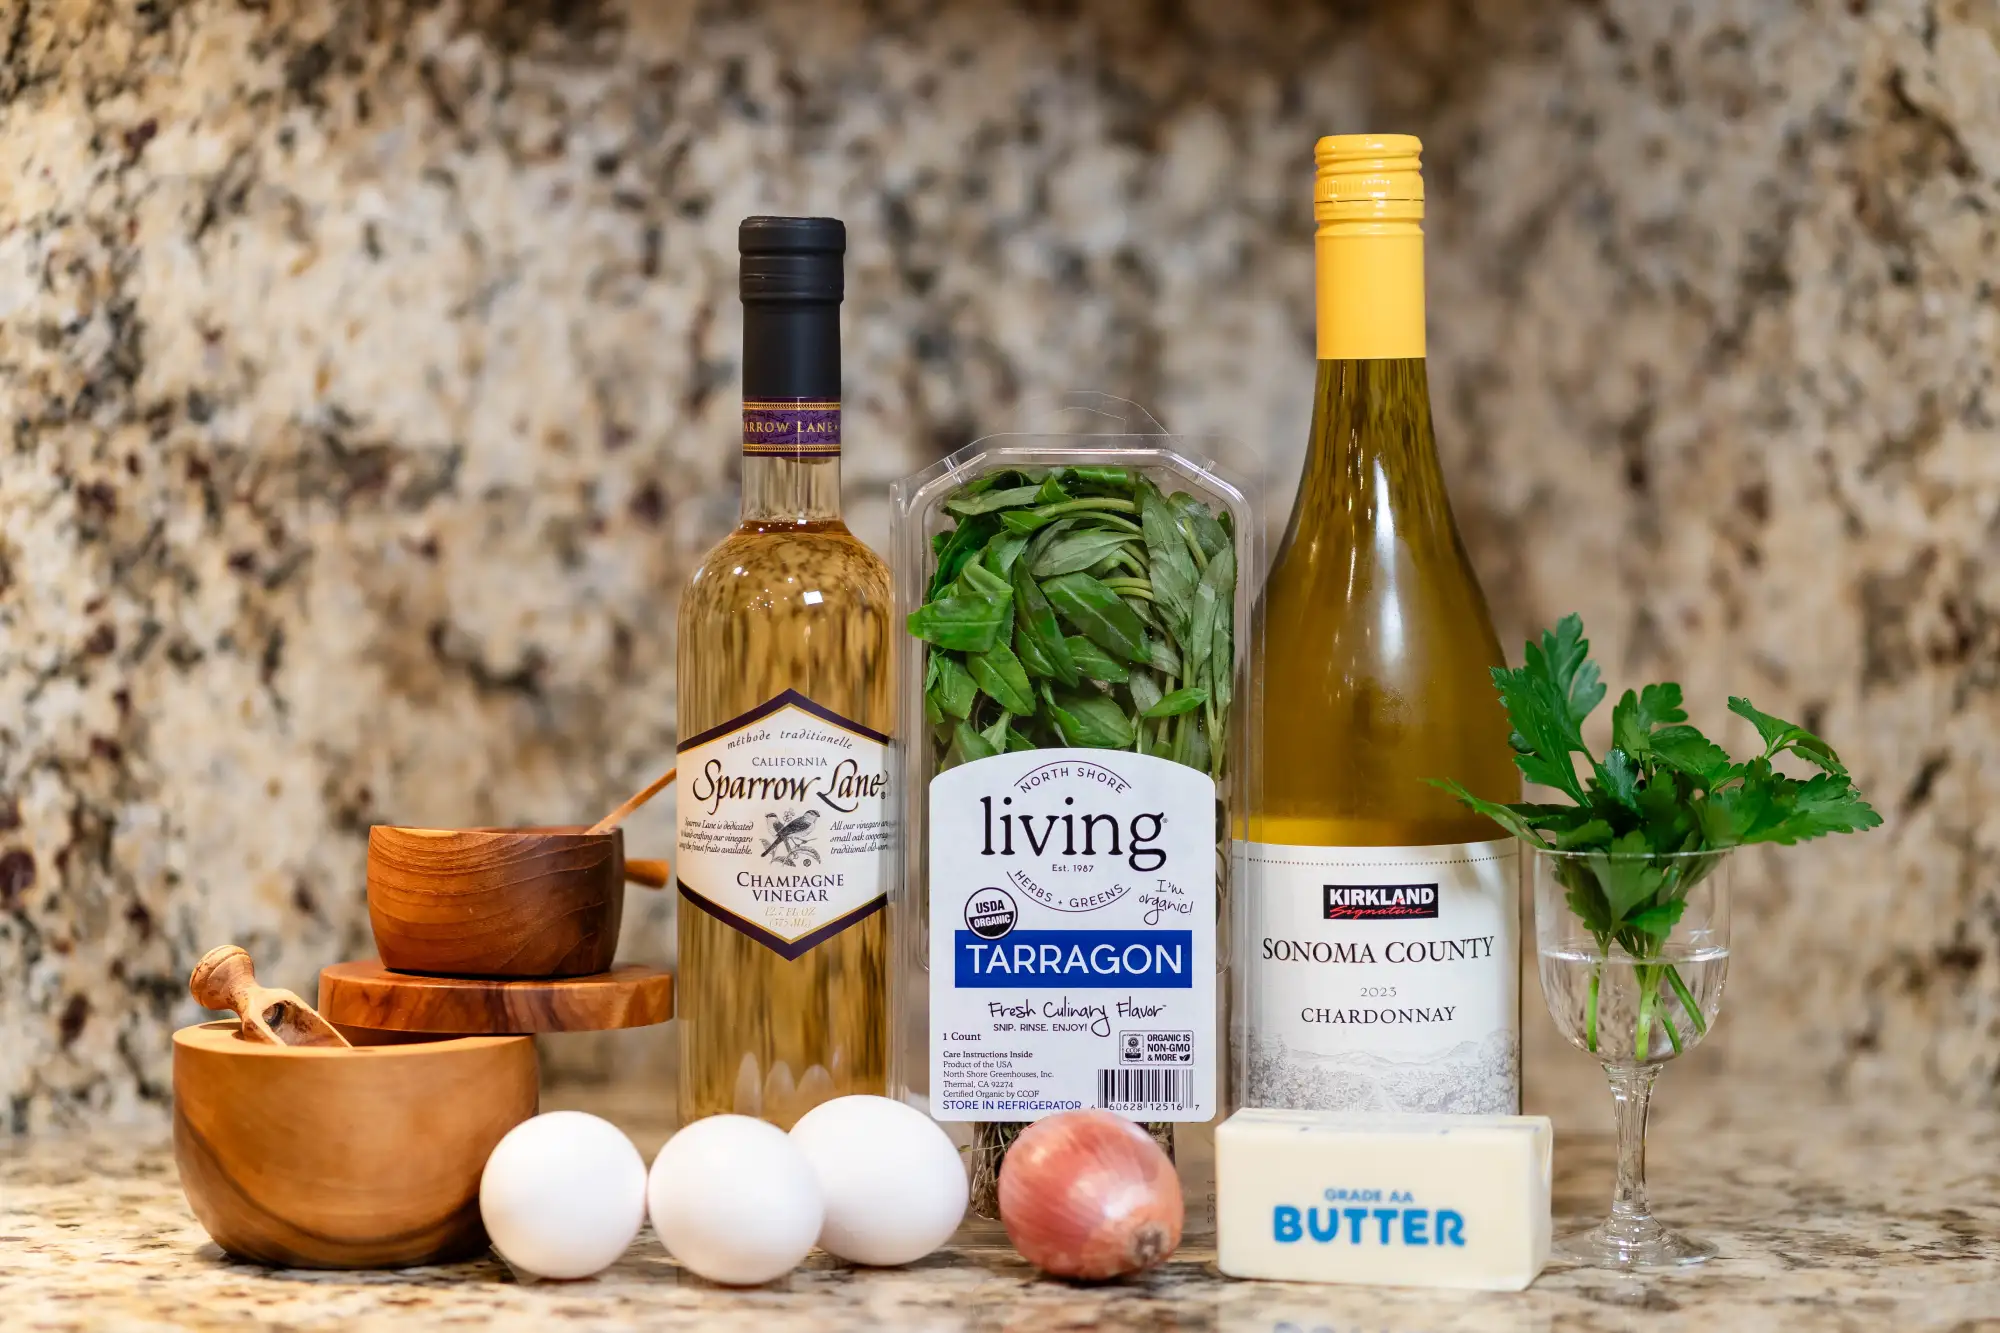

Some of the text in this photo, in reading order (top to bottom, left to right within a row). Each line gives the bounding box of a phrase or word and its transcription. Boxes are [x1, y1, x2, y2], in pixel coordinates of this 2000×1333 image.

[797, 421, 833, 432] LANE
[727, 729, 853, 750] méthode traditionelle
[752, 757, 828, 767] CALIFORNIA
[692, 759, 820, 815] Sparrow
[1020, 767, 1126, 794] NORTH SHORE
[702, 820, 716, 829] Lane
[723, 820, 754, 831] dedicated
[829, 820, 843, 831] All
[725, 833, 753, 843] vinegars
[829, 832, 852, 842] small
[852, 831, 865, 841] oak
[980, 796, 1167, 872] living
[704, 841, 720, 854] fruits
[721, 843, 753, 855] available.
[830, 843, 867, 854] traditional
[1052, 864, 1094, 873] Est. 1987
[736, 871, 844, 888] CHAMPAGNE
[1014, 869, 1053, 903] HERBS
[1069, 883, 1123, 908] GREENS
[752, 889, 829, 902] VINEGAR
[1329, 887, 1435, 906] KIRKLAND
[975, 900, 1005, 914] USDA
[1139, 893, 1194, 926] organic!
[1330, 905, 1435, 920] Signature
[973, 914, 1011, 929] ORGANIC
[1263, 935, 1495, 964] SONOMA COUNTY
[965, 944, 1182, 975] TARRAGON
[1360, 987, 1397, 998] 2023
[988, 999, 1036, 1018] Fresh
[1043, 996, 1111, 1037] Culinary
[1301, 1005, 1456, 1024] CHARDONNAY
[993, 1024, 1087, 1032] SNIP. RINSE. ENJOY!
[943, 1032, 981, 1041] 1 Count
[1147, 1034, 1190, 1042] ORGANIC IS
[1147, 1043, 1190, 1052] NON-GMO
[989, 1071, 1038, 1079] Greenhouses,
[943, 1090, 974, 1098] Certified
[975, 1090, 1005, 1099] Organic
[1006, 1090, 1015, 1099] by
[943, 1101, 1082, 1110] STORE IN REFRIGERATOR
[1109, 1103, 1143, 1111] 60628
[1150, 1103, 1183, 1111] 12516
[1324, 1188, 1414, 1202] GRADE AA
[1273, 1205, 1466, 1247] BUTTER
